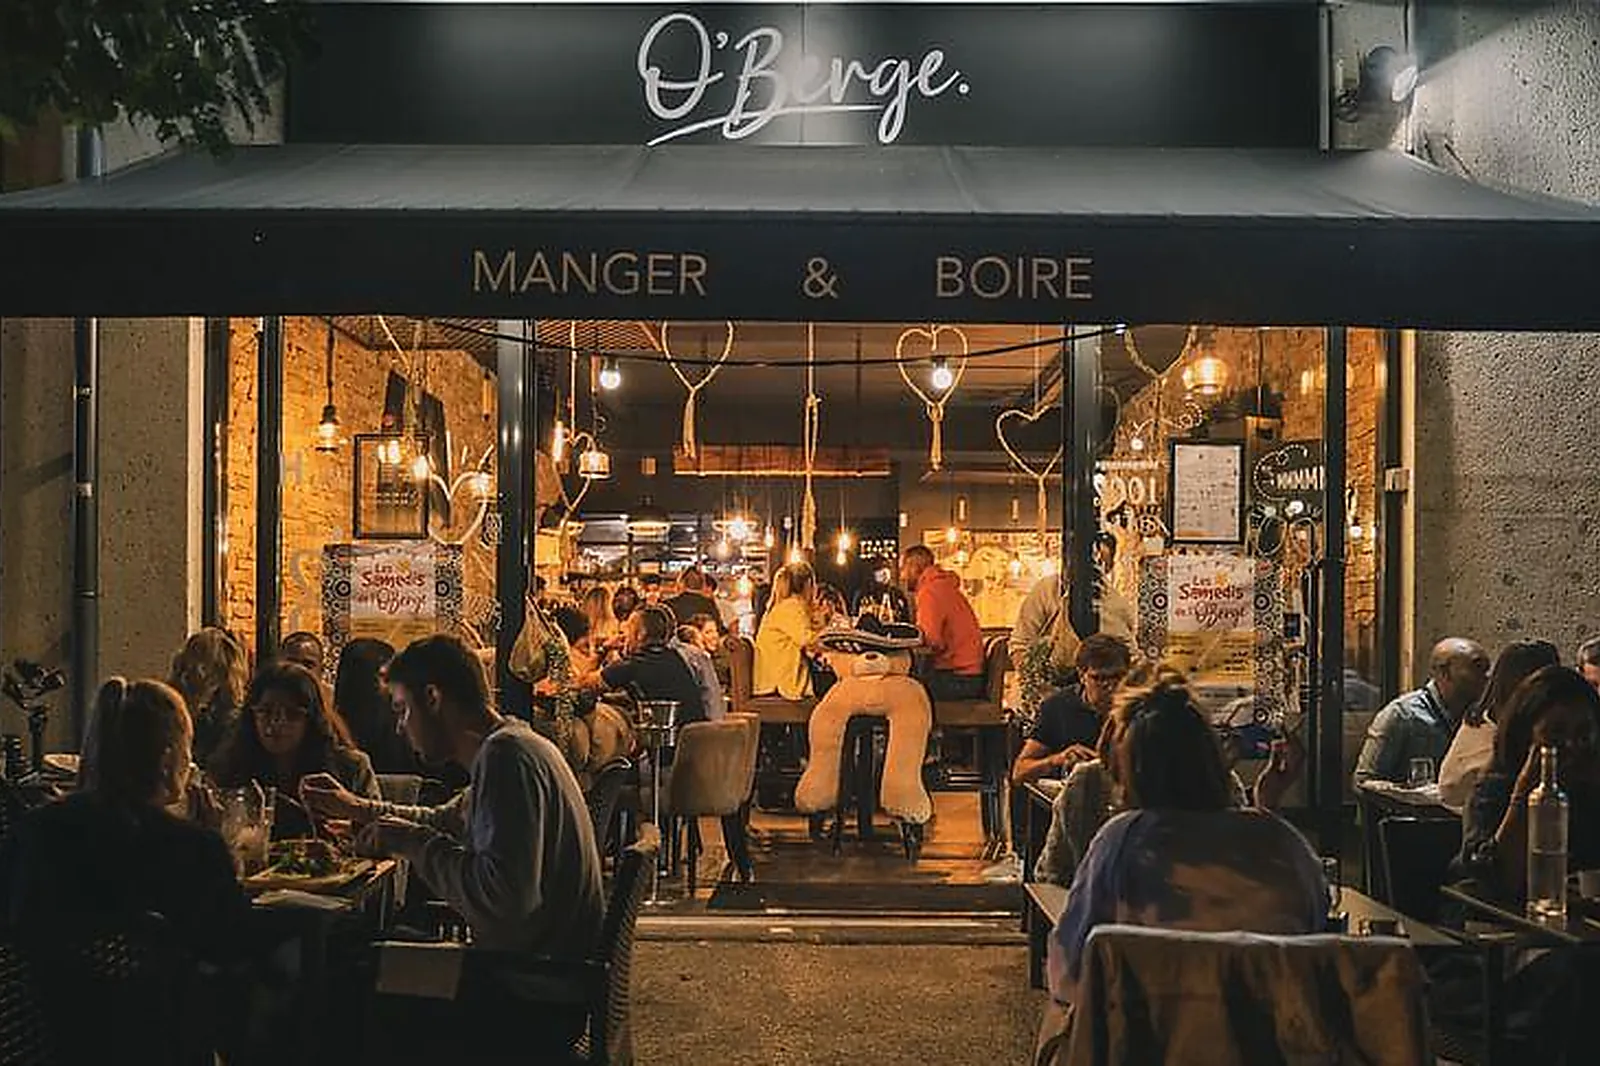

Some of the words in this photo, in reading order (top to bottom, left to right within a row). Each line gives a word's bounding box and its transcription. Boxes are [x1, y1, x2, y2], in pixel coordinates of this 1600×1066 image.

[472, 250, 707, 296] MANGER
[802, 257, 839, 298] &
[935, 256, 1094, 298] BOIRE
[1178, 582, 1245, 600] Samedis
